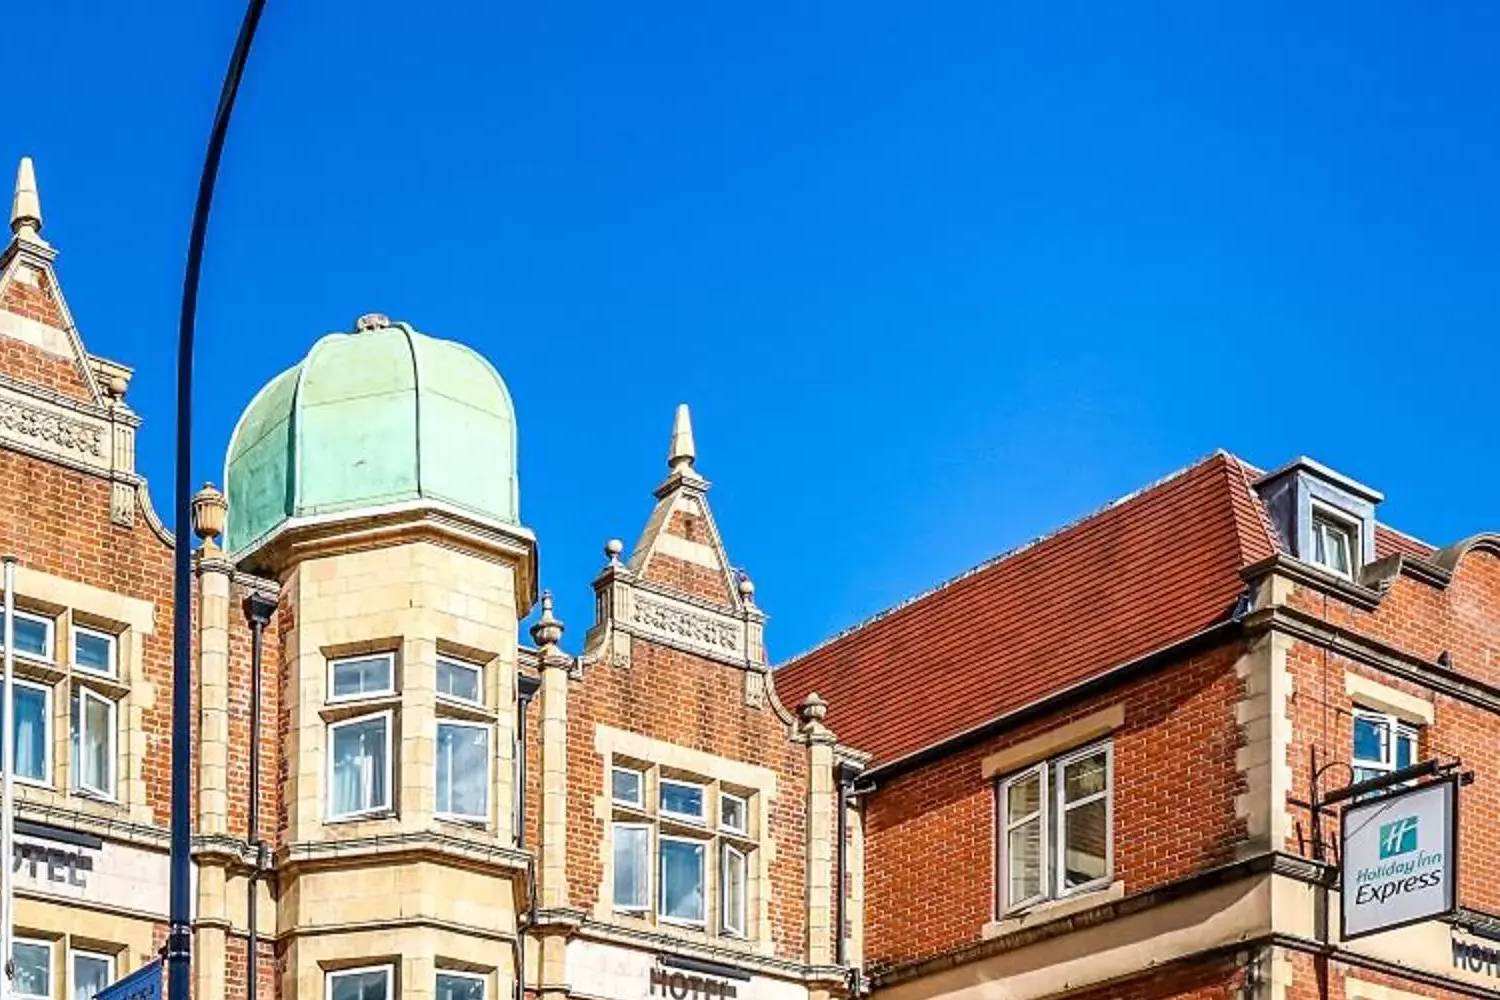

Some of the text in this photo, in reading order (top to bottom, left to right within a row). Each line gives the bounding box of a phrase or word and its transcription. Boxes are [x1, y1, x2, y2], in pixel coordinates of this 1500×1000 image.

[1356, 850, 1443, 884] Holiday Inn
[1355, 869, 1442, 905] Express
